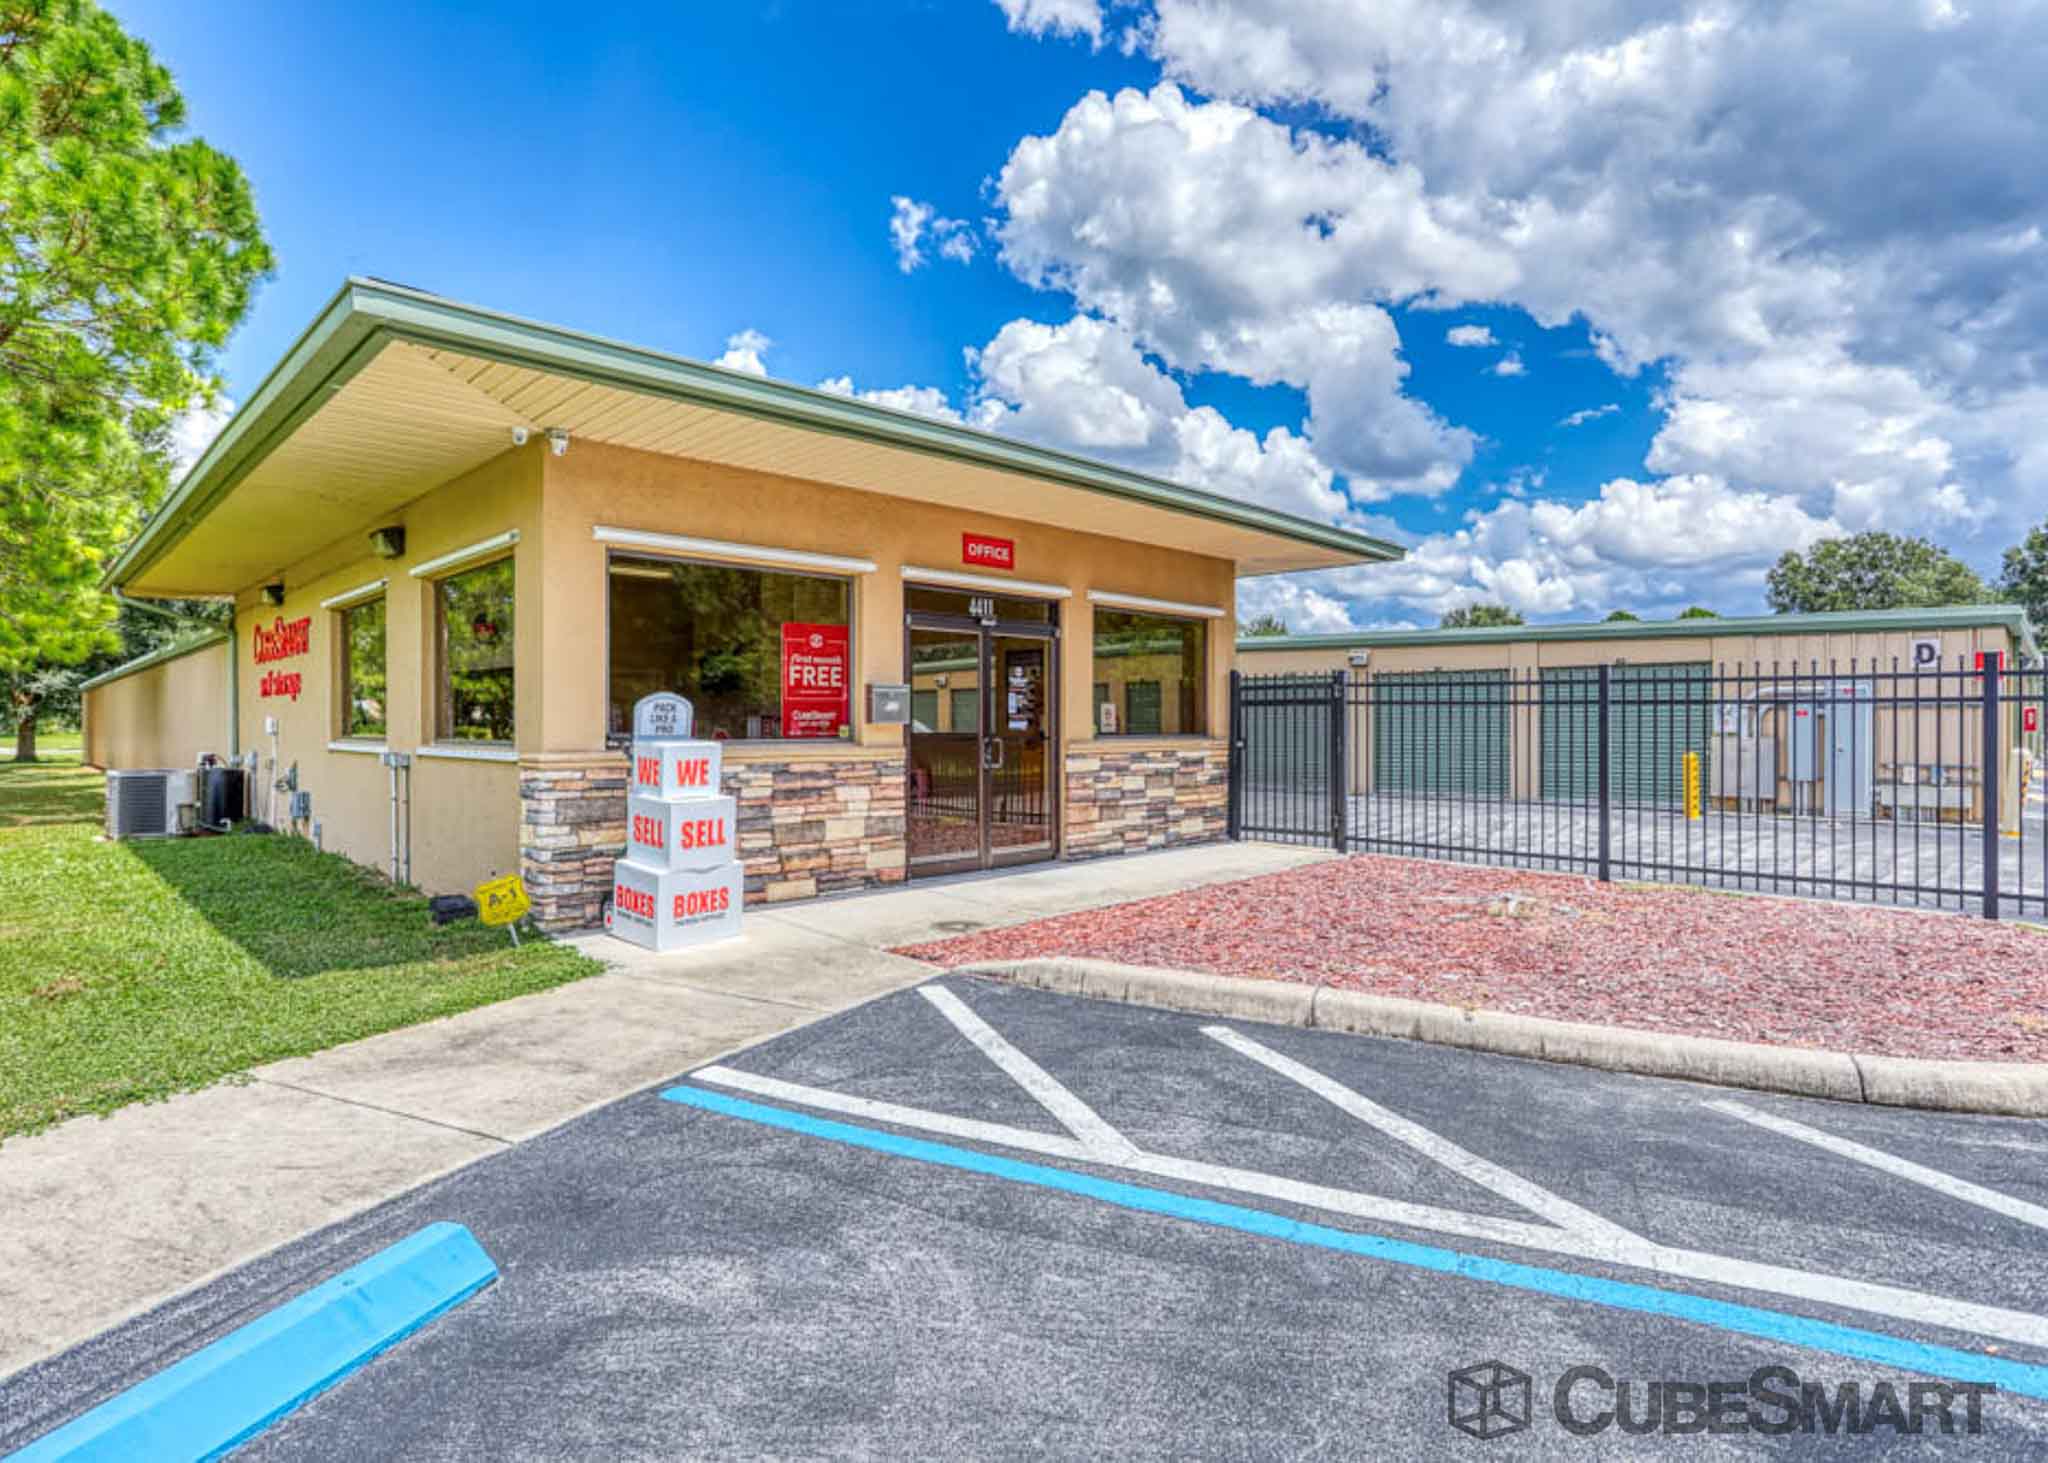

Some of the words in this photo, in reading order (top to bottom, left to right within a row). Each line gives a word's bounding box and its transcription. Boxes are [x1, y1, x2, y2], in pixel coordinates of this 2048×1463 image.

[968, 543, 1009, 561] OFFICE
[969, 597, 993, 617] 4411
[1916, 643, 1936, 665] D
[789, 666, 843, 687] FREE
[637, 755, 660, 787] WE
[676, 759, 710, 787] WE
[633, 812, 664, 849] SELL
[680, 818, 727, 850] SELL
[615, 884, 655, 919] BOXES
[673, 886, 729, 919] BOXES
